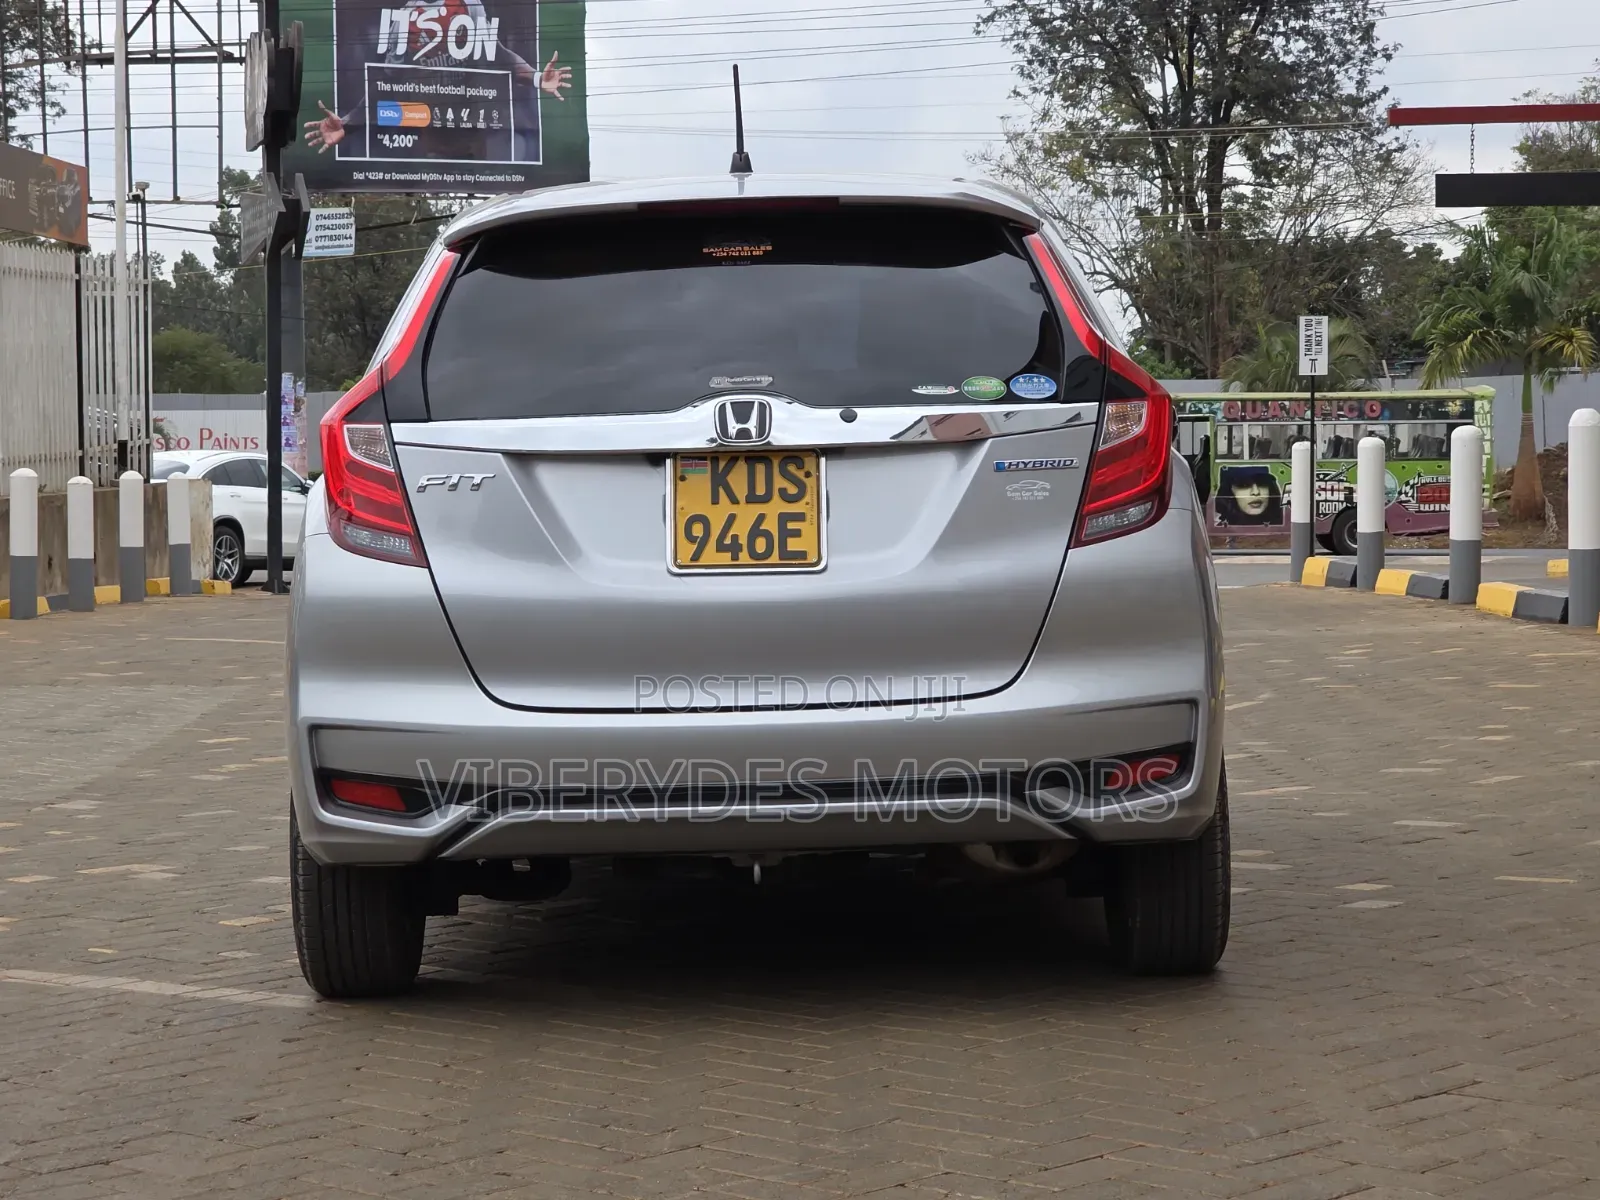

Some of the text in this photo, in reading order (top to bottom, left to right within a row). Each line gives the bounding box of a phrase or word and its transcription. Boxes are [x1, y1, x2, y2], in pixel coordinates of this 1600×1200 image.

[447, 14, 499, 61] ON
[376, 81, 497, 99] The world's best football package
[353, 172, 365, 180] Dial
[392, 172, 421, 181] Download
[443, 173, 455, 183] App
[455, 173, 462, 181] to
[463, 174, 475, 184] stay
[475, 174, 505, 182] Connected
[1304, 318, 1314, 357] THANK YOU
[1314, 330, 1323, 346] NEXT
[1223, 399, 1382, 420] QUANTICO
[1007, 459, 1075, 470] HYBRID
[416, 473, 496, 493] FIT
[710, 455, 808, 505] KDS
[684, 512, 808, 562] 946E
